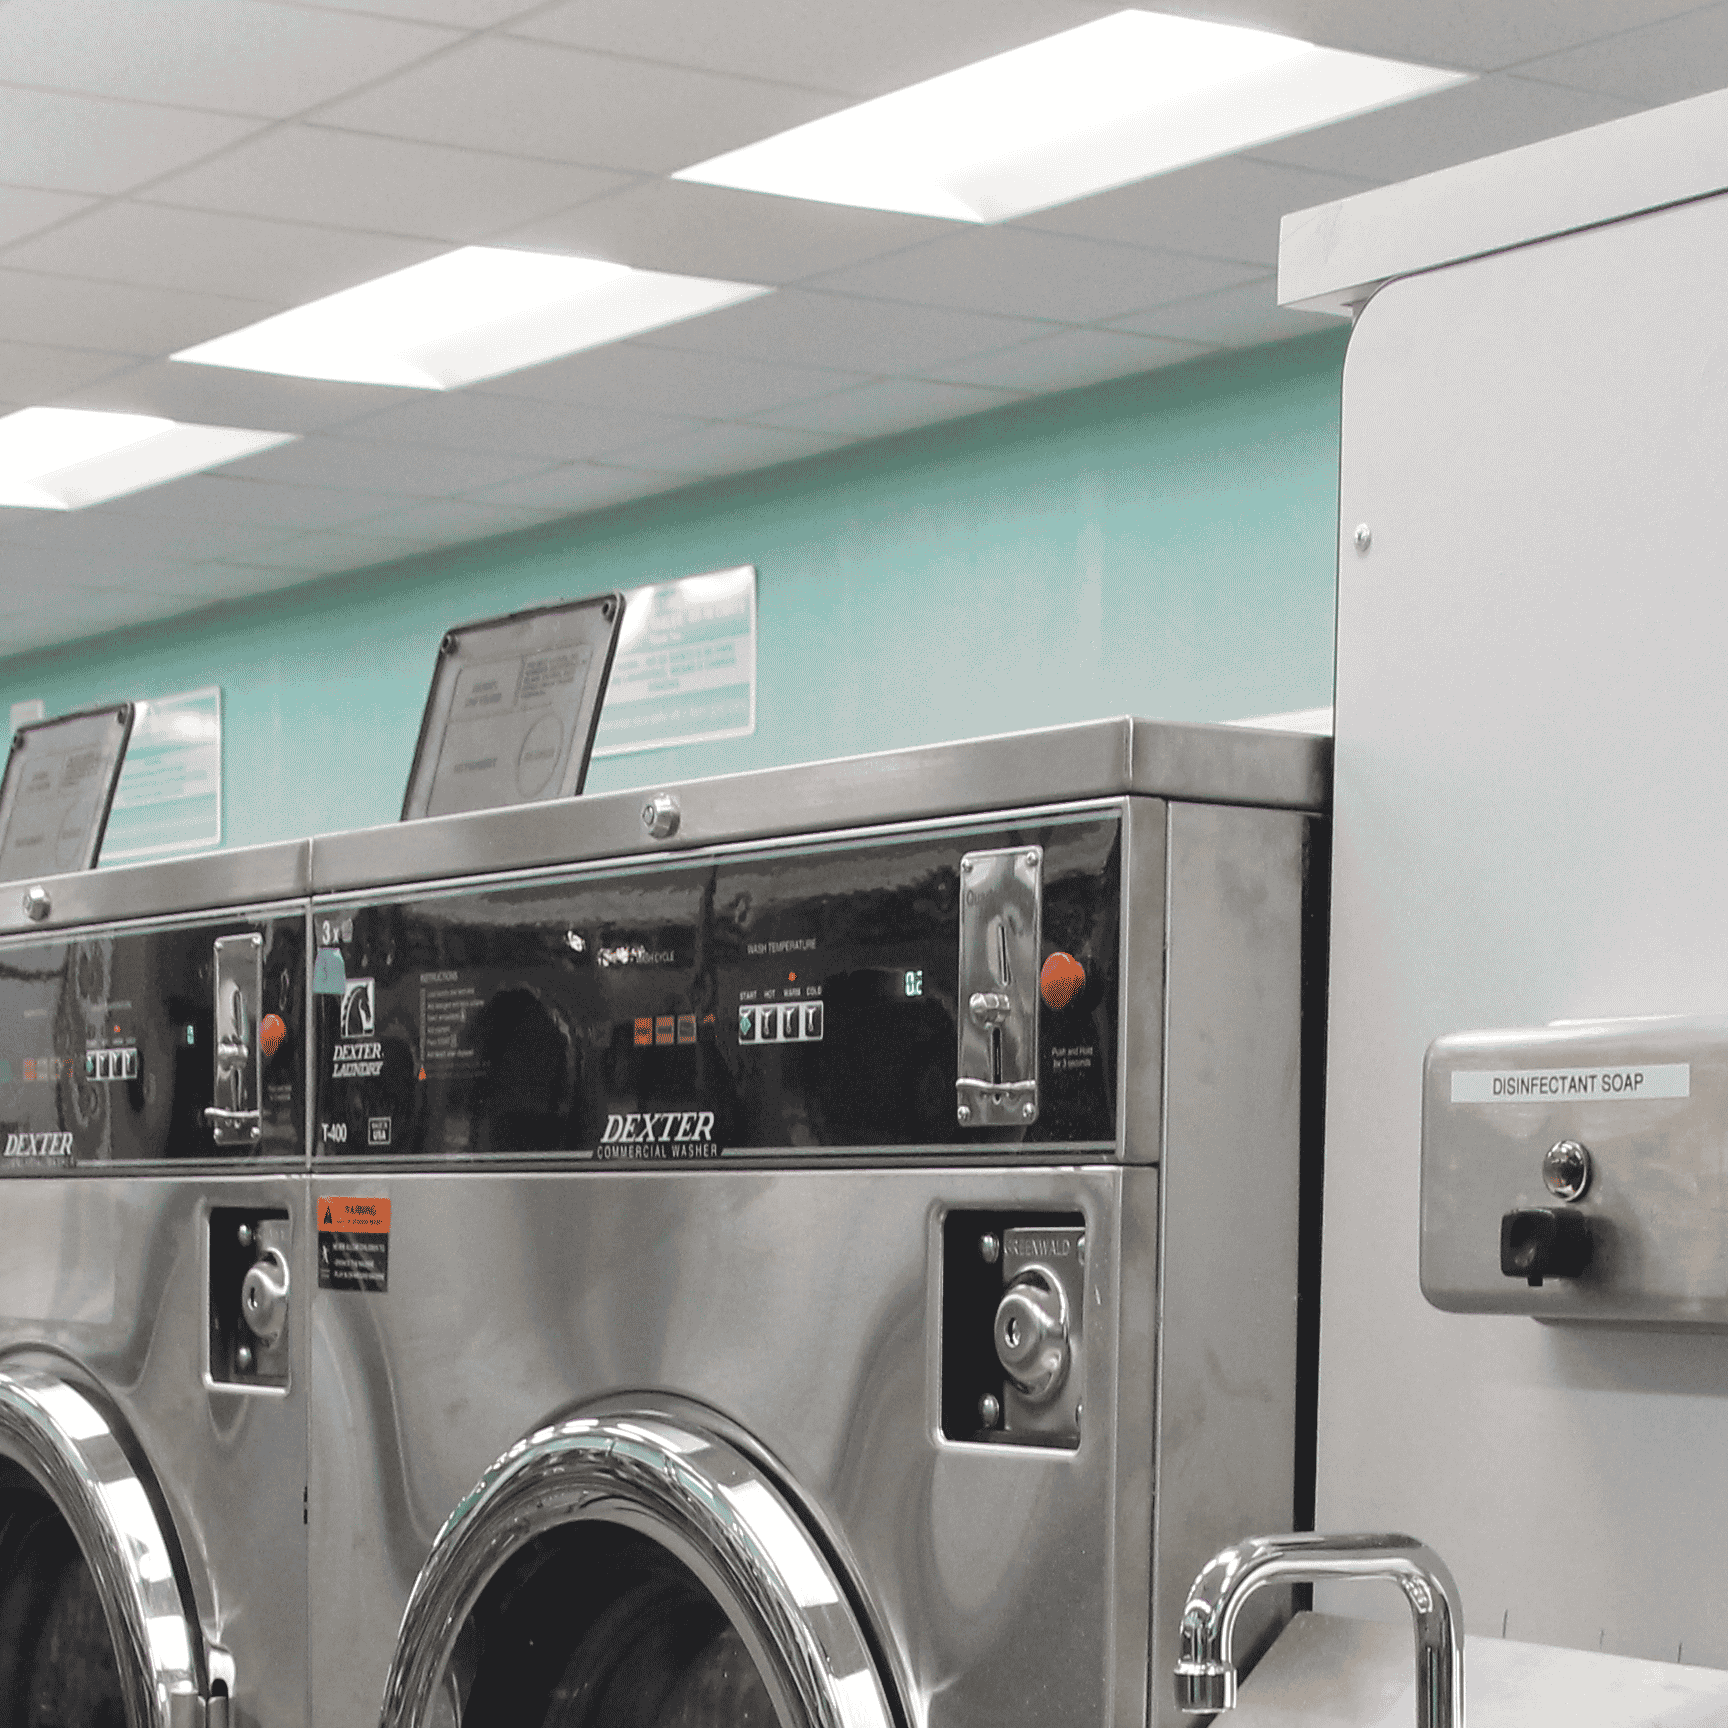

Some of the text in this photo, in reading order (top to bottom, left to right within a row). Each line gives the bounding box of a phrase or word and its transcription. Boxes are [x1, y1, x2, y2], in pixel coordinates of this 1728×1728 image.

[739, 990, 757, 1000] START
[806, 986, 822, 996] COLD
[333, 1042, 382, 1061] DEXTER
[332, 1061, 384, 1078] LAUNDRY
[1492, 1072, 1645, 1096] DISINFECTANT SOAP
[600, 1111, 716, 1144] DEXTER
[3, 1132, 74, 1157] DEXTER
[596, 1142, 718, 1161] COMMERCIAL WASHER
[1003, 1238, 1072, 1256] GREENWALD
